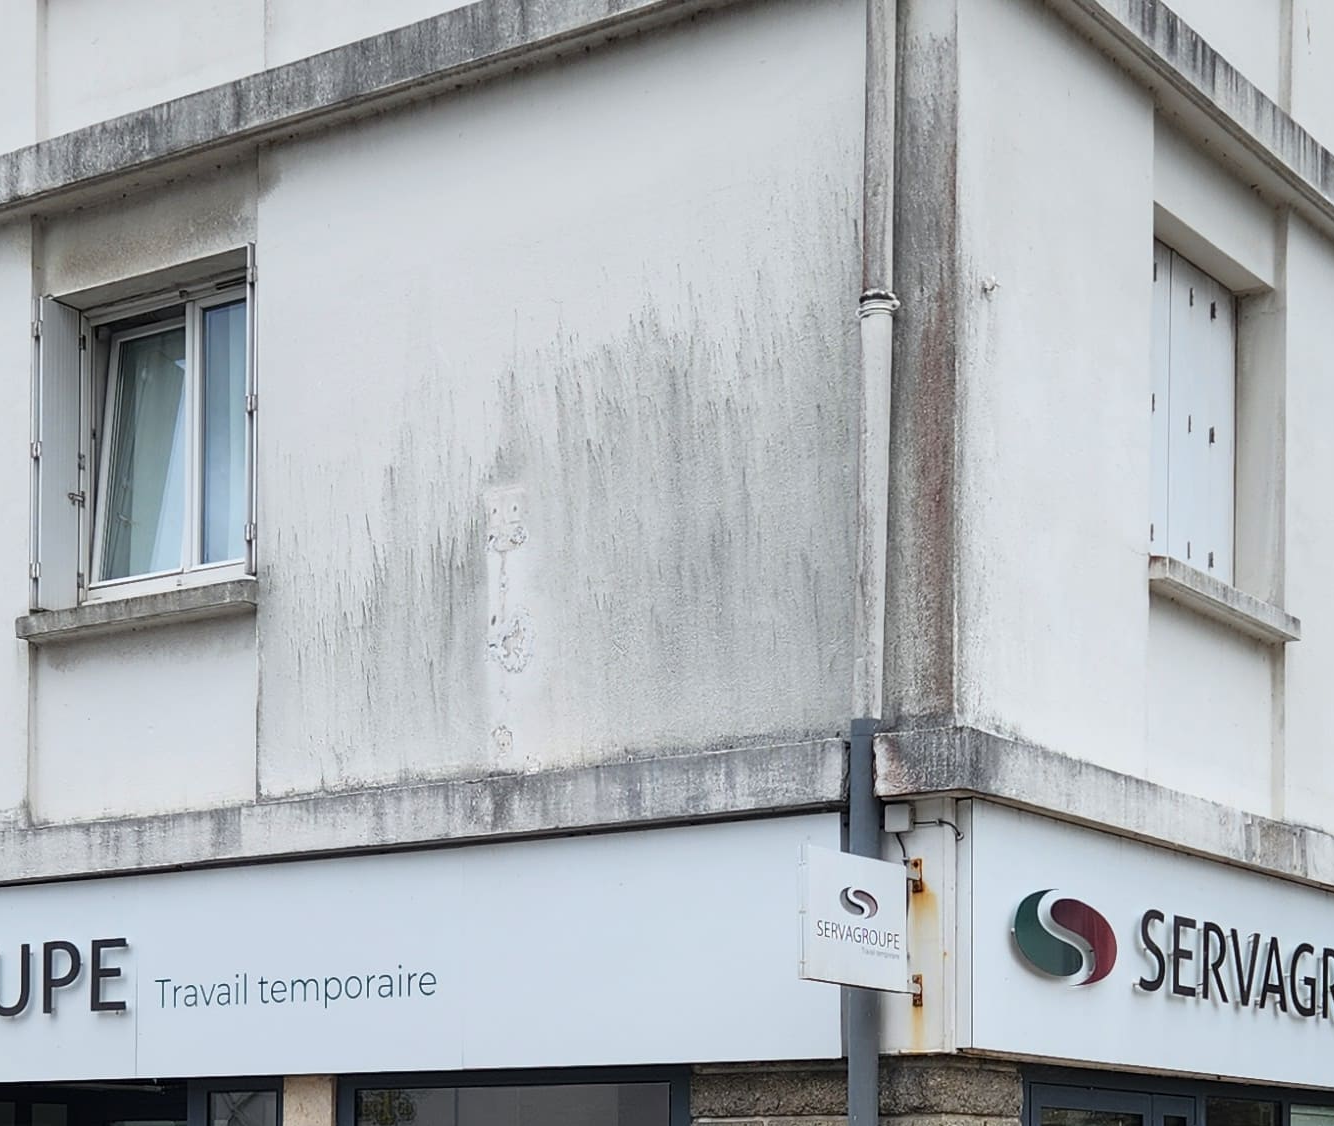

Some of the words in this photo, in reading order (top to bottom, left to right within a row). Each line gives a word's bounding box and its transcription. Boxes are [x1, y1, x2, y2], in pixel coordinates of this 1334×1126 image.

[817, 920, 900, 950] SERVAGROUPE
[155, 973, 247, 1009] Travail
[258, 964, 437, 1009] temporaire
